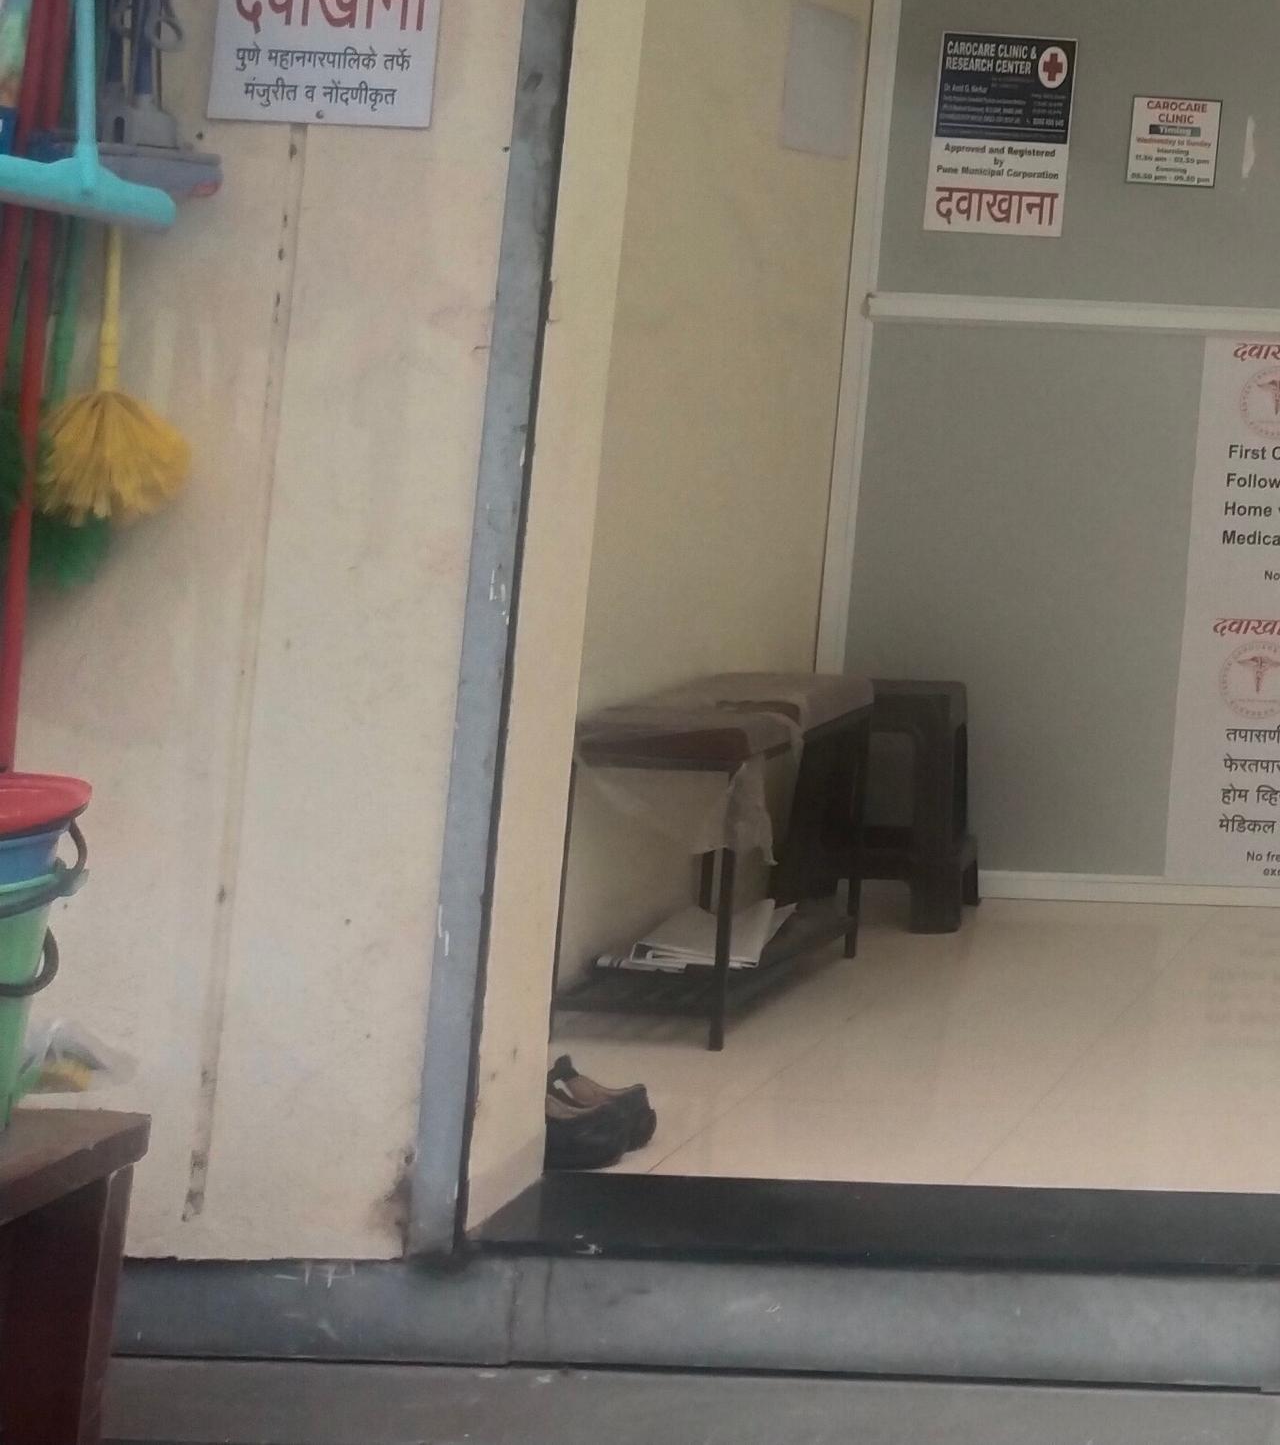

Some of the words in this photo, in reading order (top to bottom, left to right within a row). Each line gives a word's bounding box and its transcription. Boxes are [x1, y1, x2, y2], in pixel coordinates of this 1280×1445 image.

[235, 42, 260, 72] पुणे
[383, 49, 411, 72] तर्फे
[947, 41, 995, 56] CAROCARE
[998, 44, 1028, 58] CLINIC
[1031, 47, 1037, 58] &
[946, 57, 993, 72] RESEARCH
[996, 60, 1031, 74] CENTER
[244, 77, 297, 107] मंजुरीत
[304, 86, 315, 102] व
[1147, 101, 1208, 113] CAROCARE
[1158, 114, 1194, 124] CLINIC
[936, 186, 1059, 225] दवाखाना
[1228, 445, 1267, 460] First
[1226, 473, 1280, 489] Follow
[1224, 502, 1272, 517] Home
[1264, 570, 1280, 581] No
[1221, 787, 1248, 805] होम
[1219, 815, 1276, 835] मेडिकल
